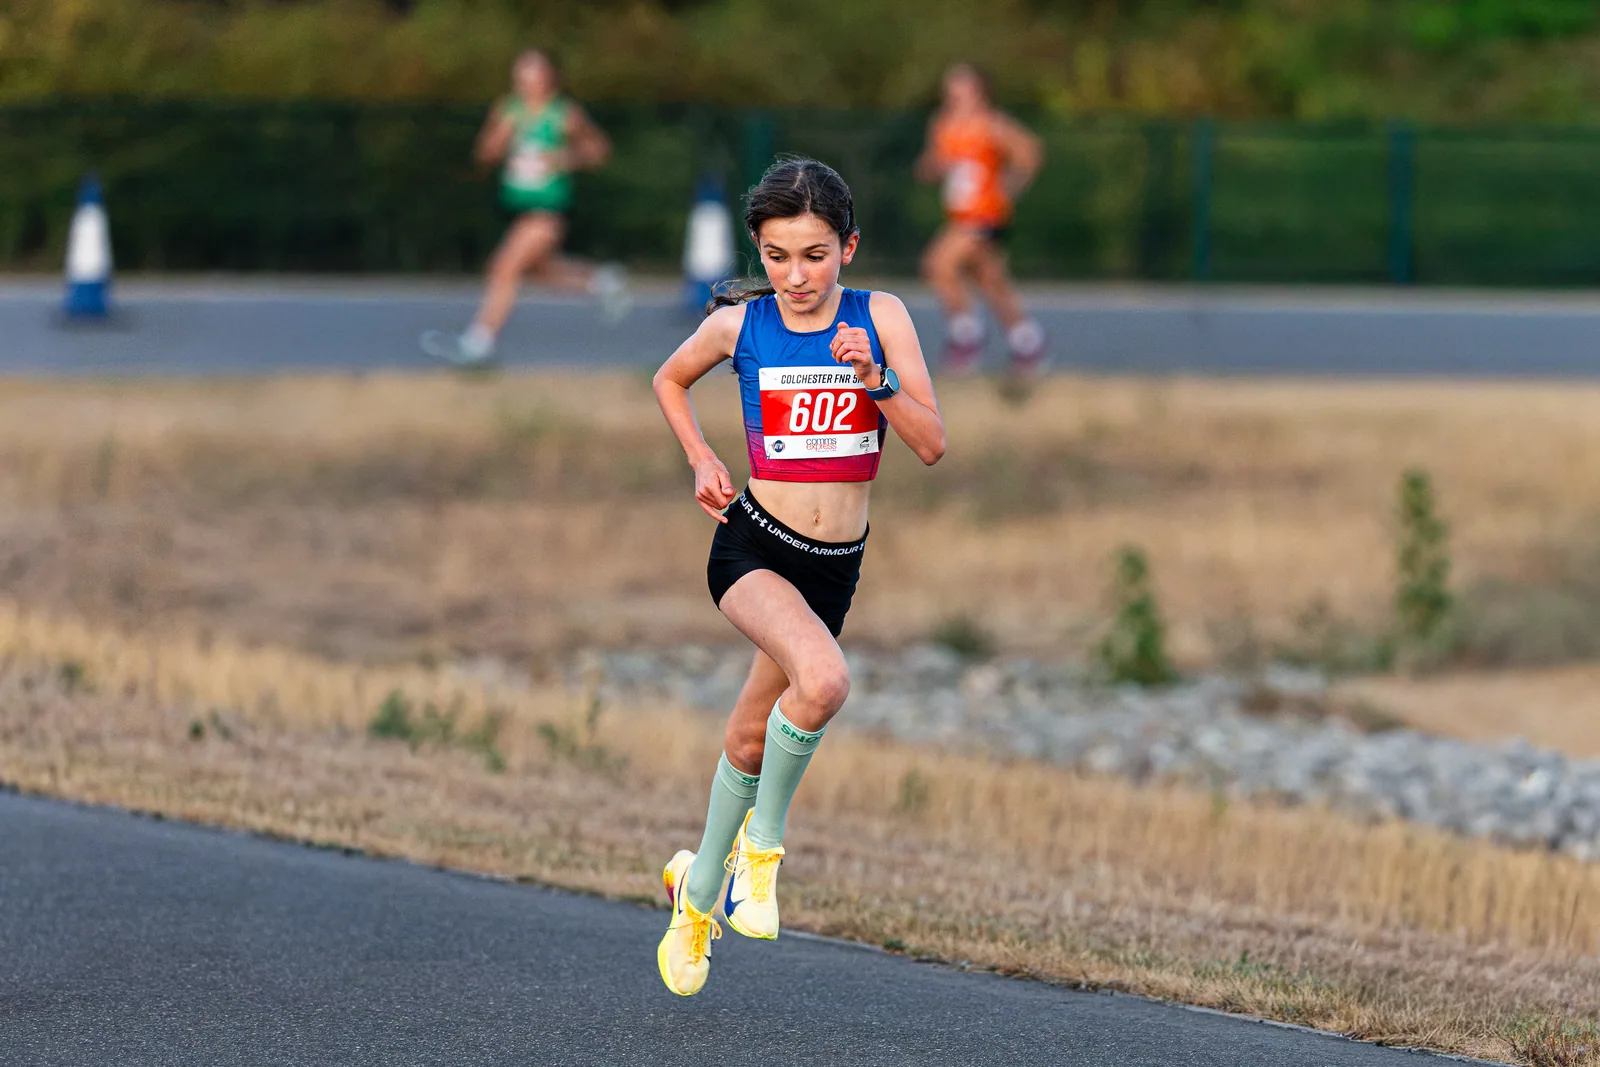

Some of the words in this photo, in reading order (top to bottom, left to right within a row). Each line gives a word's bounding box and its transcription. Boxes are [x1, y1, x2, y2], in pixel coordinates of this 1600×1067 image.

[781, 373, 832, 384] COLCHESTER
[834, 373, 851, 384] FNR
[789, 391, 858, 433] 602
[767, 523, 810, 552] UNDER
[809, 545, 859, 556] ARMOUR
[781, 724, 823, 743] SNO
